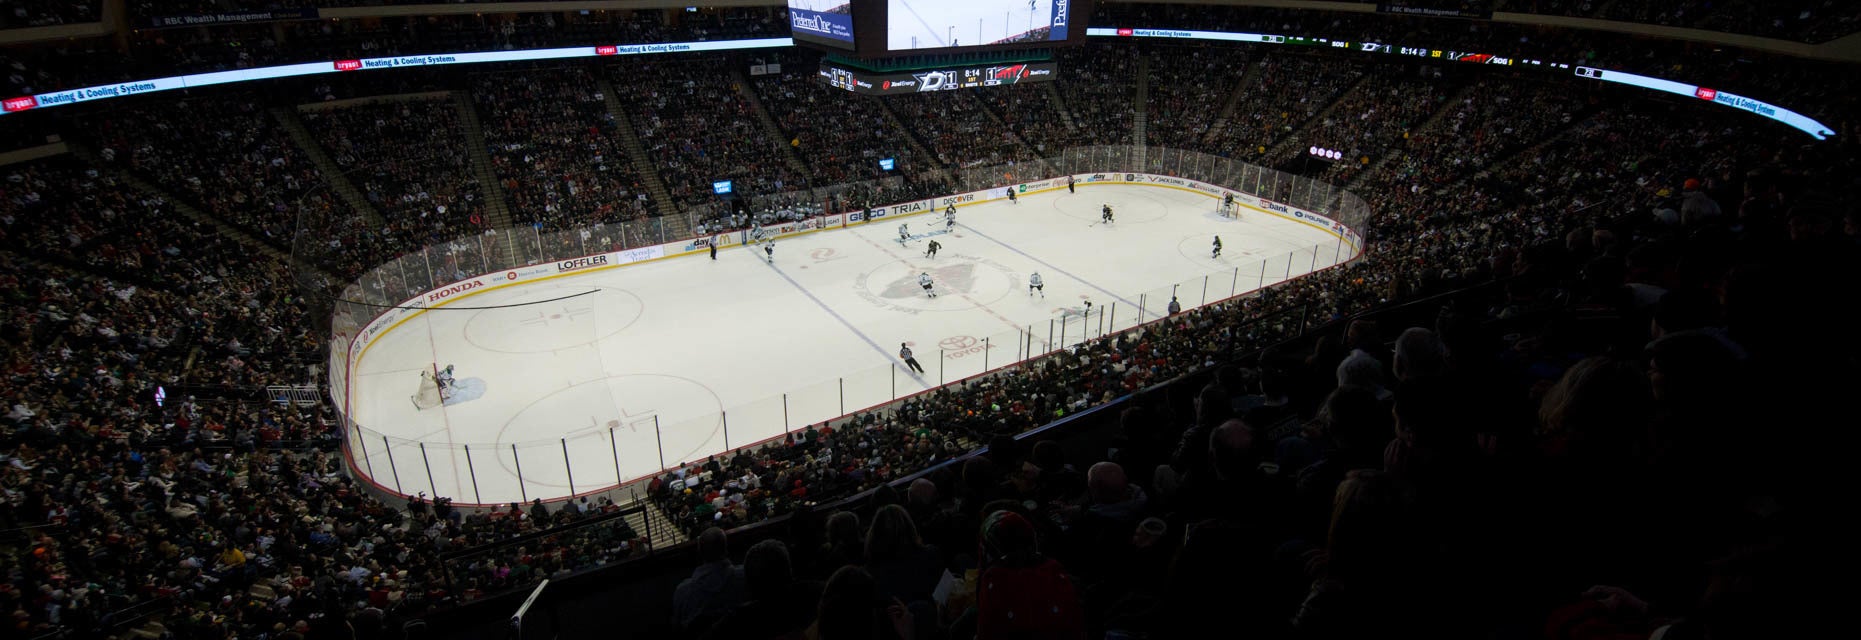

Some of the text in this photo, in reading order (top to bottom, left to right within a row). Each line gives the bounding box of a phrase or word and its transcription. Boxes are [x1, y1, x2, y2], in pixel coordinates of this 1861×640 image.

[186, 14, 216, 24] Wealth
[218, 12, 272, 22] Management
[1400, 47, 1418, 55] 8:14
[365, 59, 392, 68] Heating
[401, 56, 426, 65] Cooling
[428, 55, 456, 64] Systems
[964, 69, 980, 77] 8:14
[6, 82, 156, 110] bryant Heating & Cooling Systems
[892, 202, 921, 215] TRIA
[1270, 202, 1288, 213] bank
[850, 208, 885, 222] GECO
[694, 238, 709, 250] day
[558, 255, 607, 270] LOFFLER
[428, 280, 484, 302] HONDA
[944, 344, 996, 360] TOYOTA
